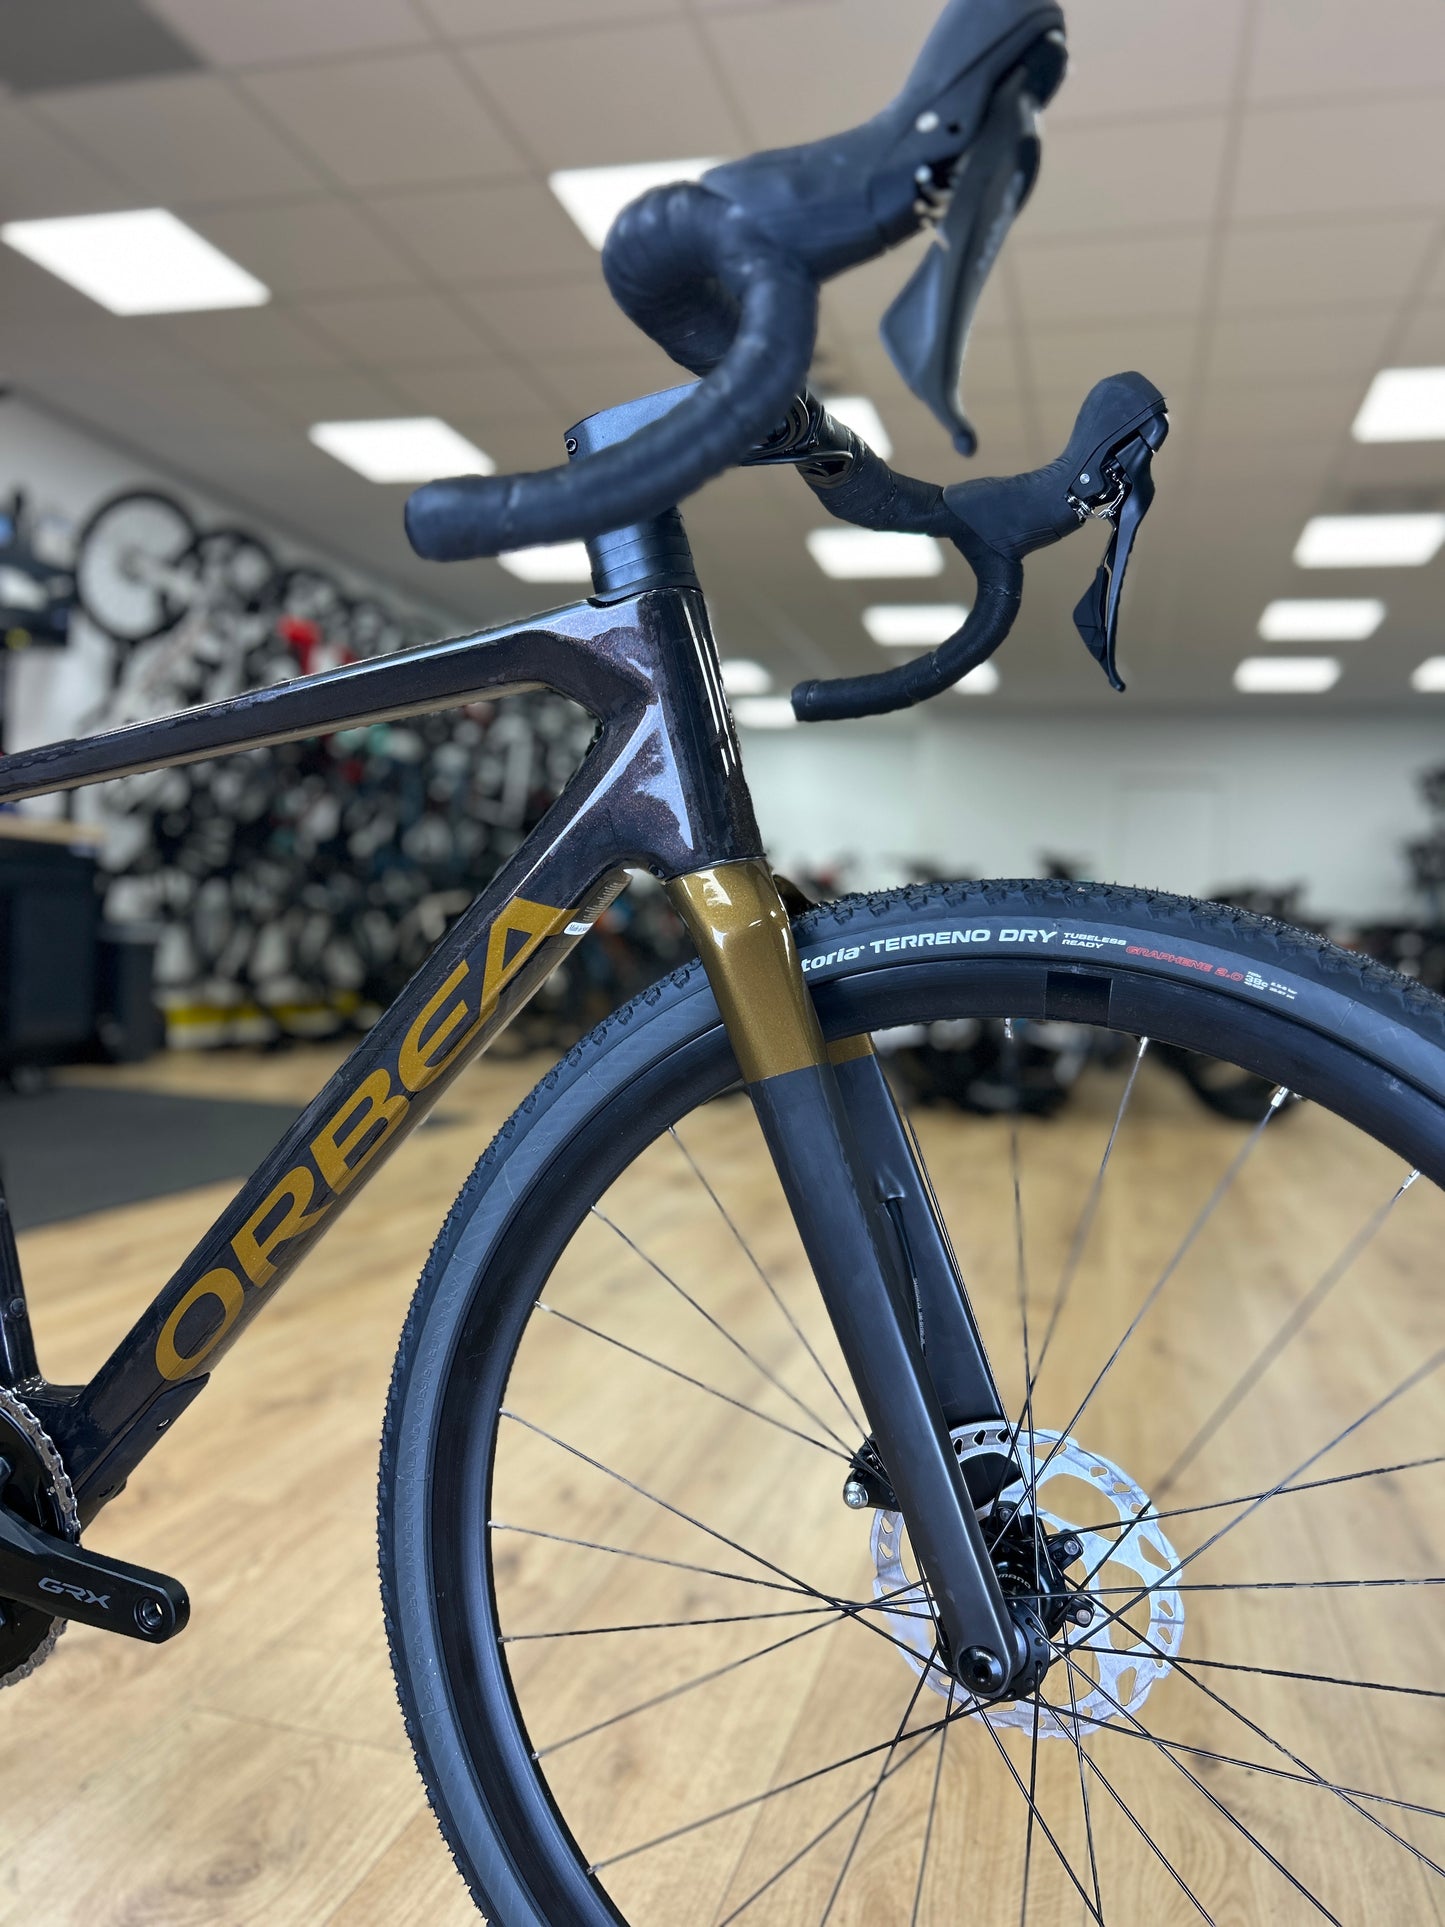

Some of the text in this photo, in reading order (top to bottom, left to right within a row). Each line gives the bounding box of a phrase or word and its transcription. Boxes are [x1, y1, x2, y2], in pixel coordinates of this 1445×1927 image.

[801, 929, 1058, 972] toria TERRENO DRY
[1061, 939, 1104, 949] READY
[1063, 932, 1127, 946] TUBELESS
[1126, 946, 1244, 982] GRAPHENE 2.0
[155, 896, 580, 1381] ORBEA
[38, 1577, 110, 1609] GRX
[998, 1573, 1031, 1590] MANO
